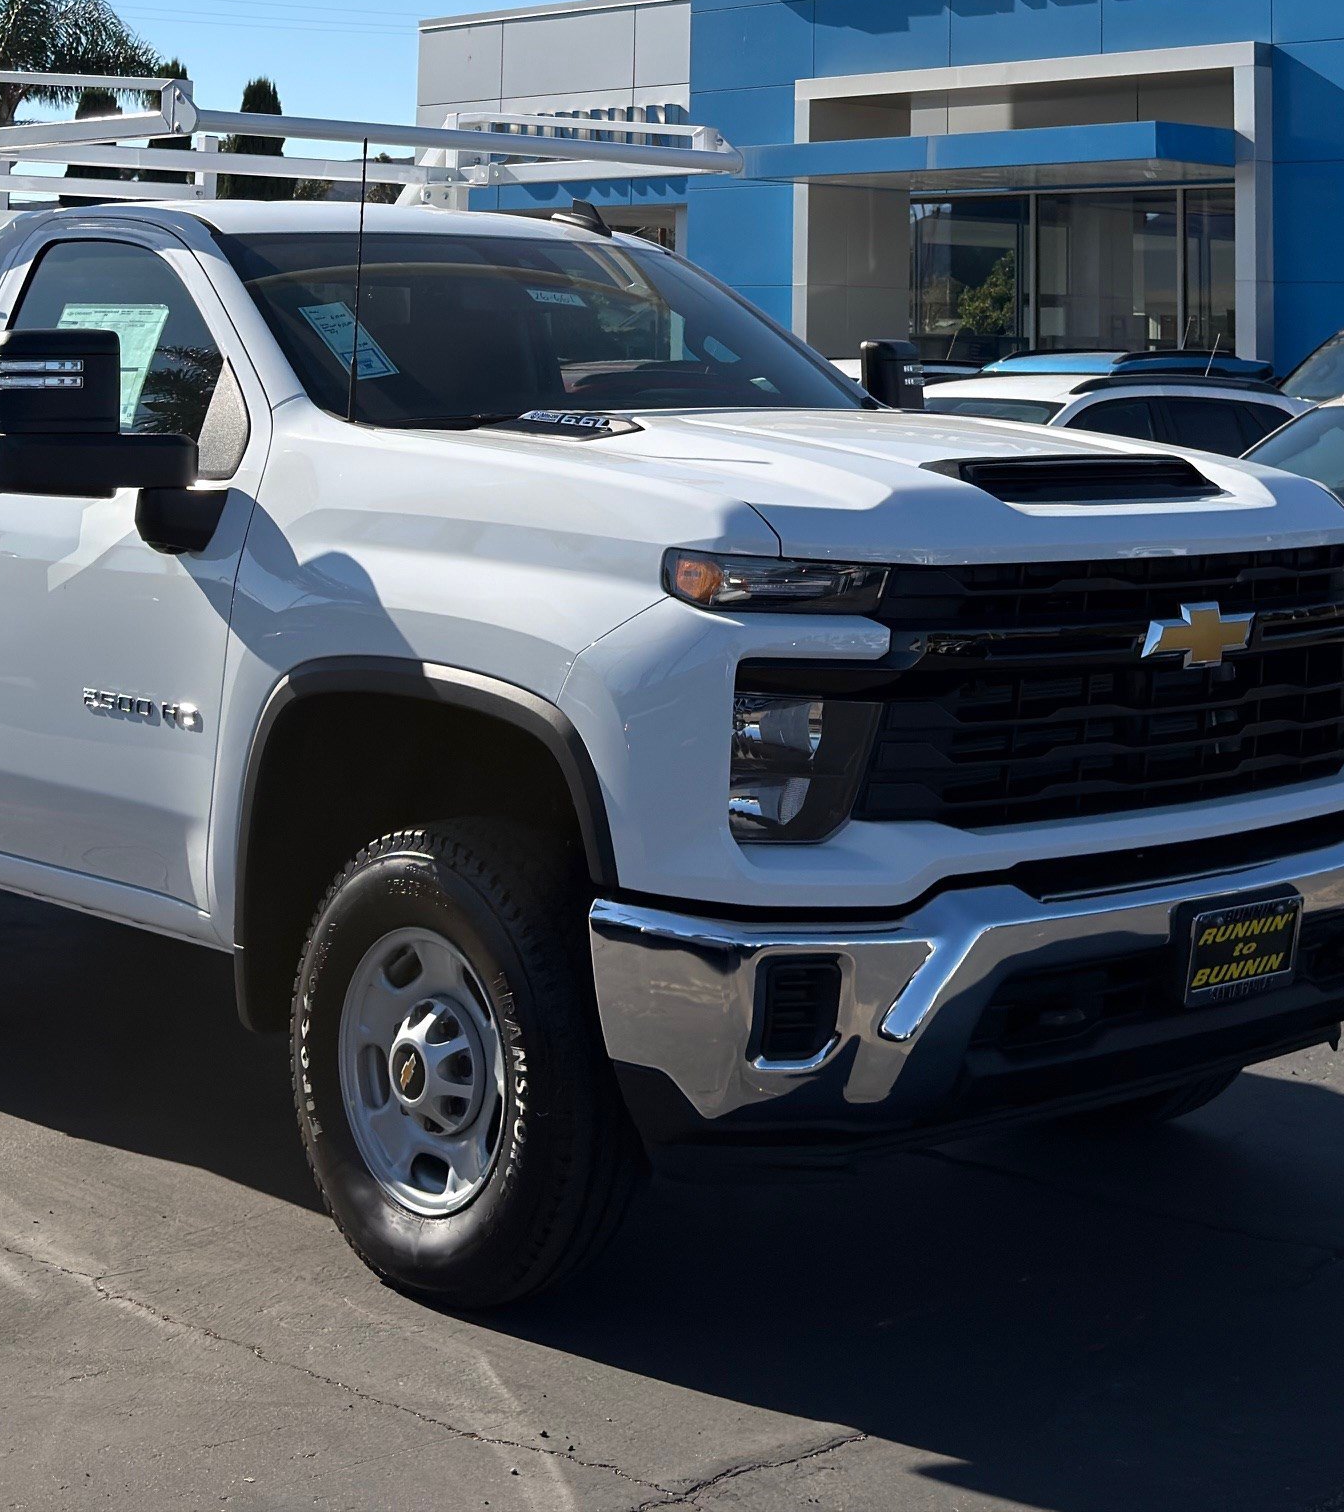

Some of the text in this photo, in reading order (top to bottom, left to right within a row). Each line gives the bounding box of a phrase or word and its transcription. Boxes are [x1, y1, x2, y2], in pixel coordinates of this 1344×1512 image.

[82, 686, 153, 716] 2500
[1197, 912, 1295, 946] RUNNIN'
[1232, 942, 1257, 957] to
[1190, 952, 1285, 988] BUNNIN
